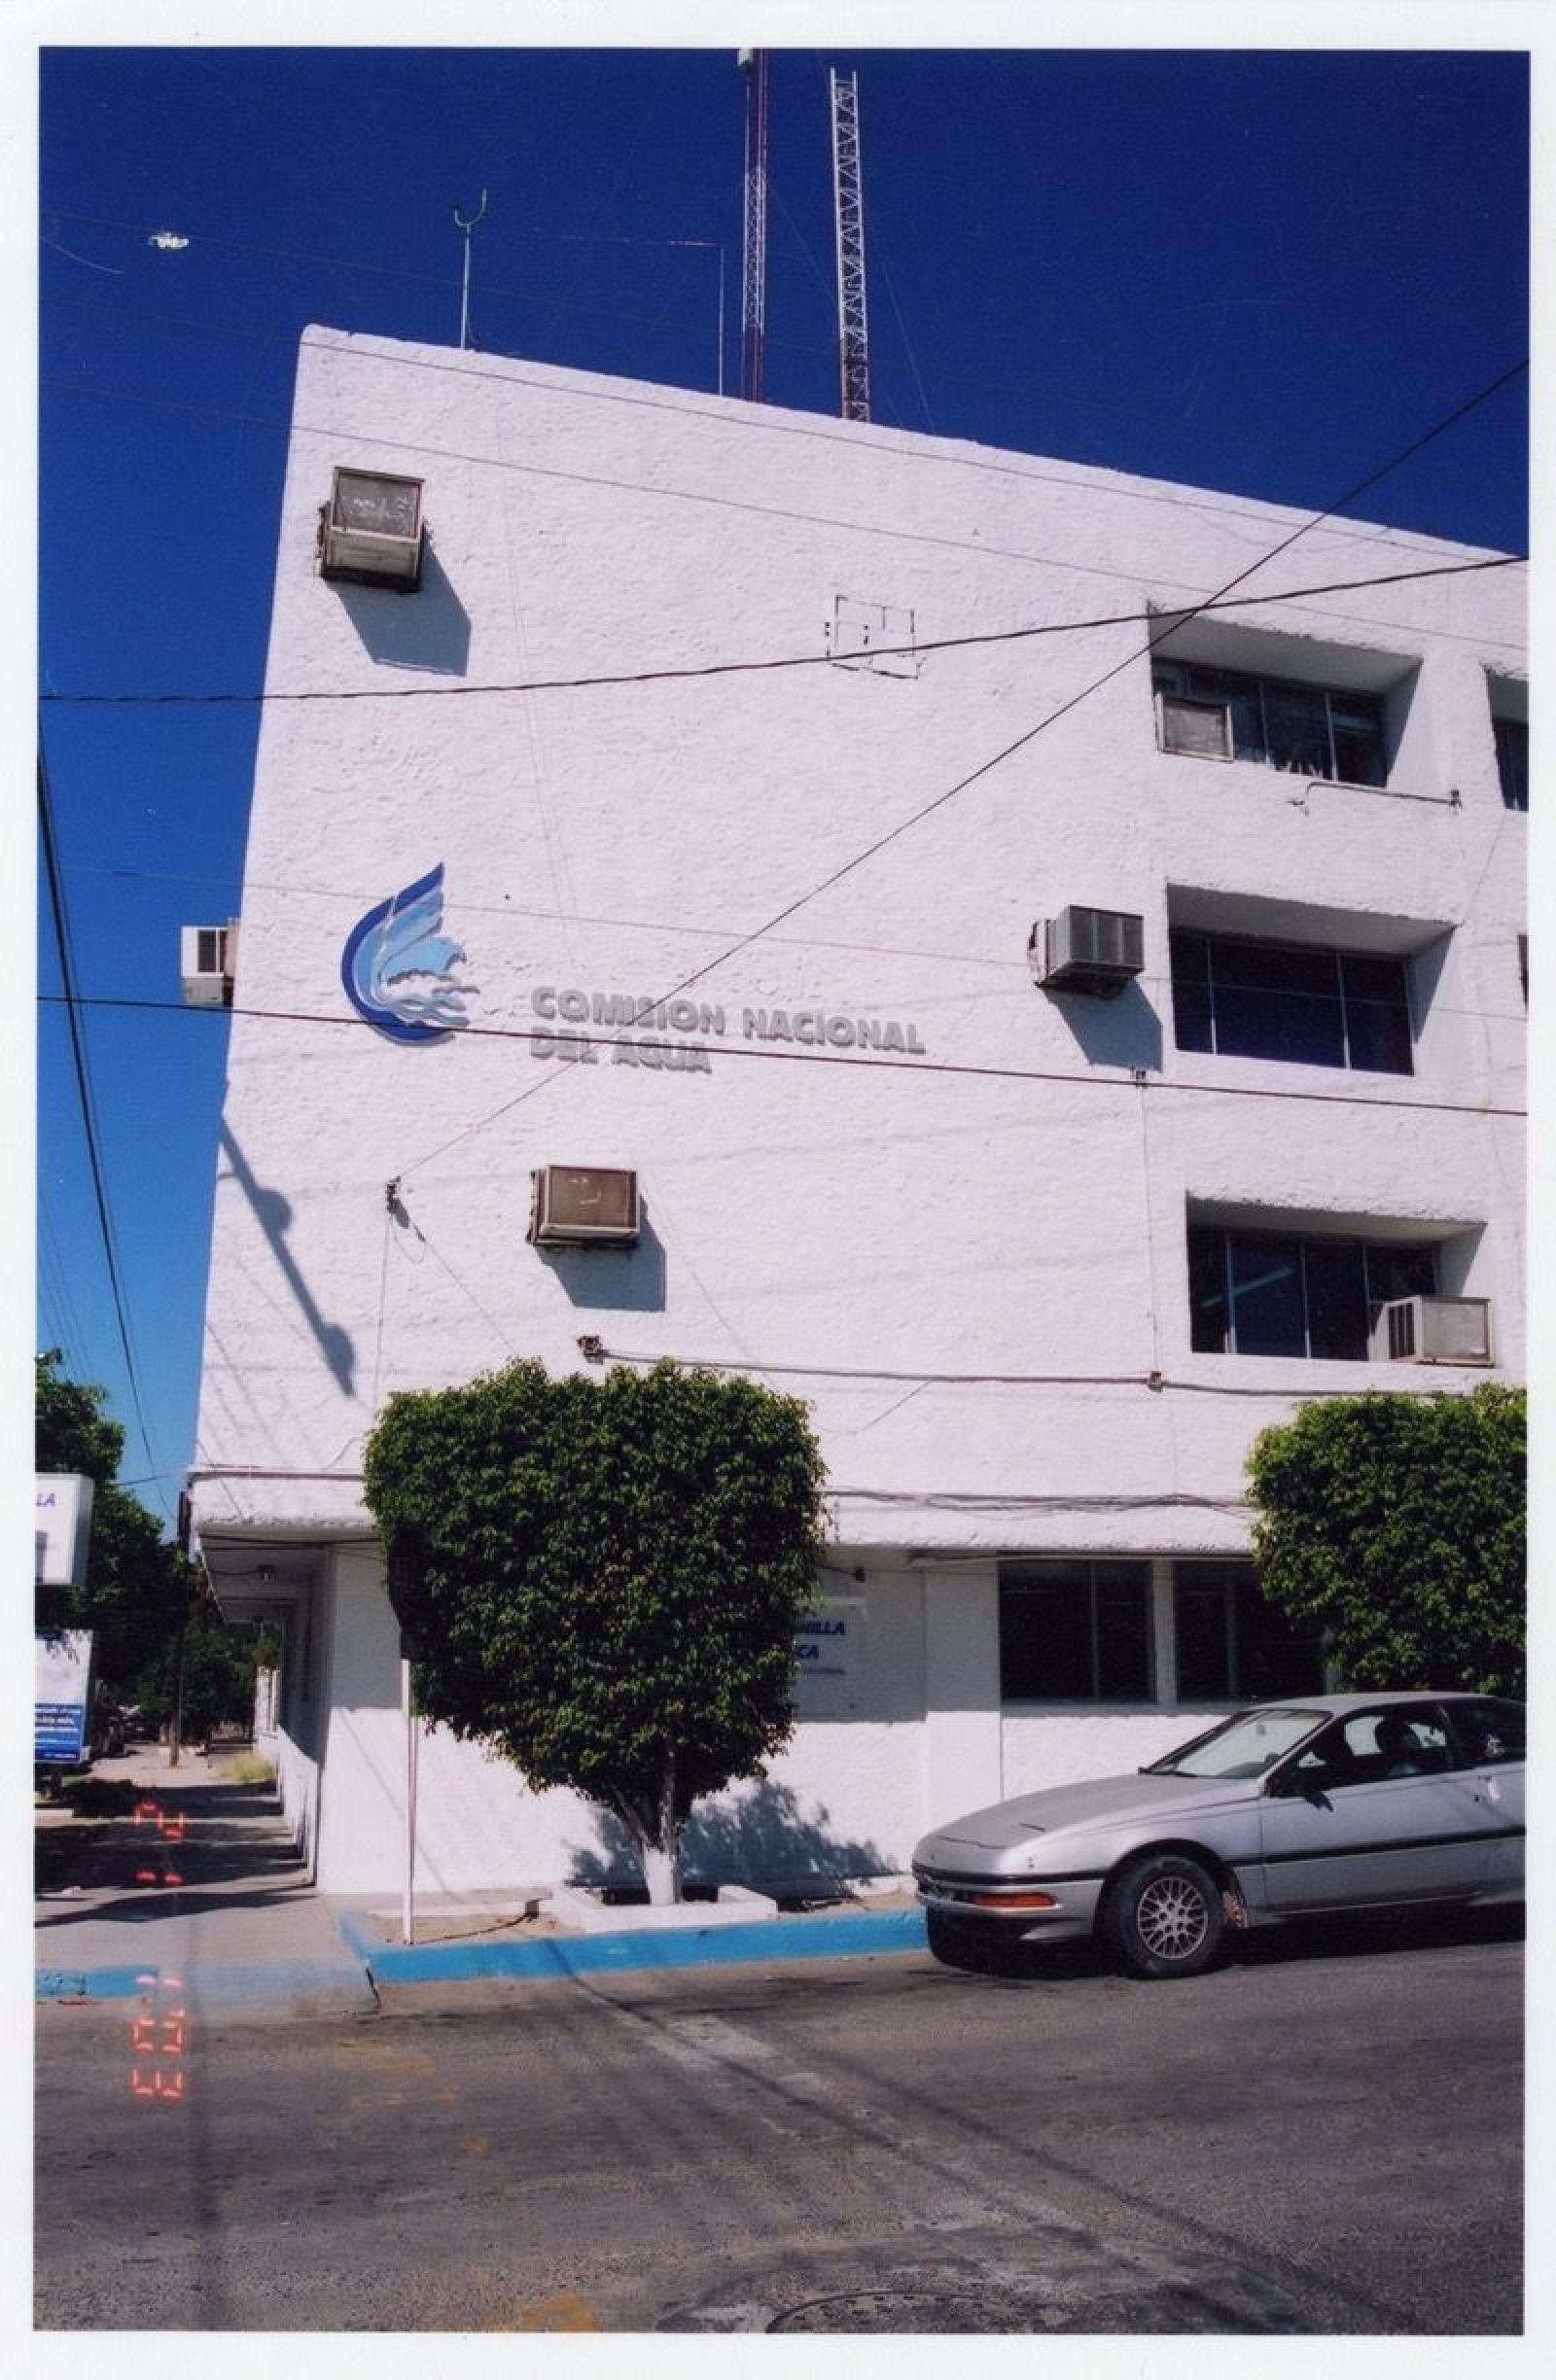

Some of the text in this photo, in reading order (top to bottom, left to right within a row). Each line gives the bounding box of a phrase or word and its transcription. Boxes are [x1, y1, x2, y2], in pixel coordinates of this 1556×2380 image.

[531, 987, 927, 1055] COMISION NACIONAL
[530, 1027, 713, 1074] DEL AGUA
